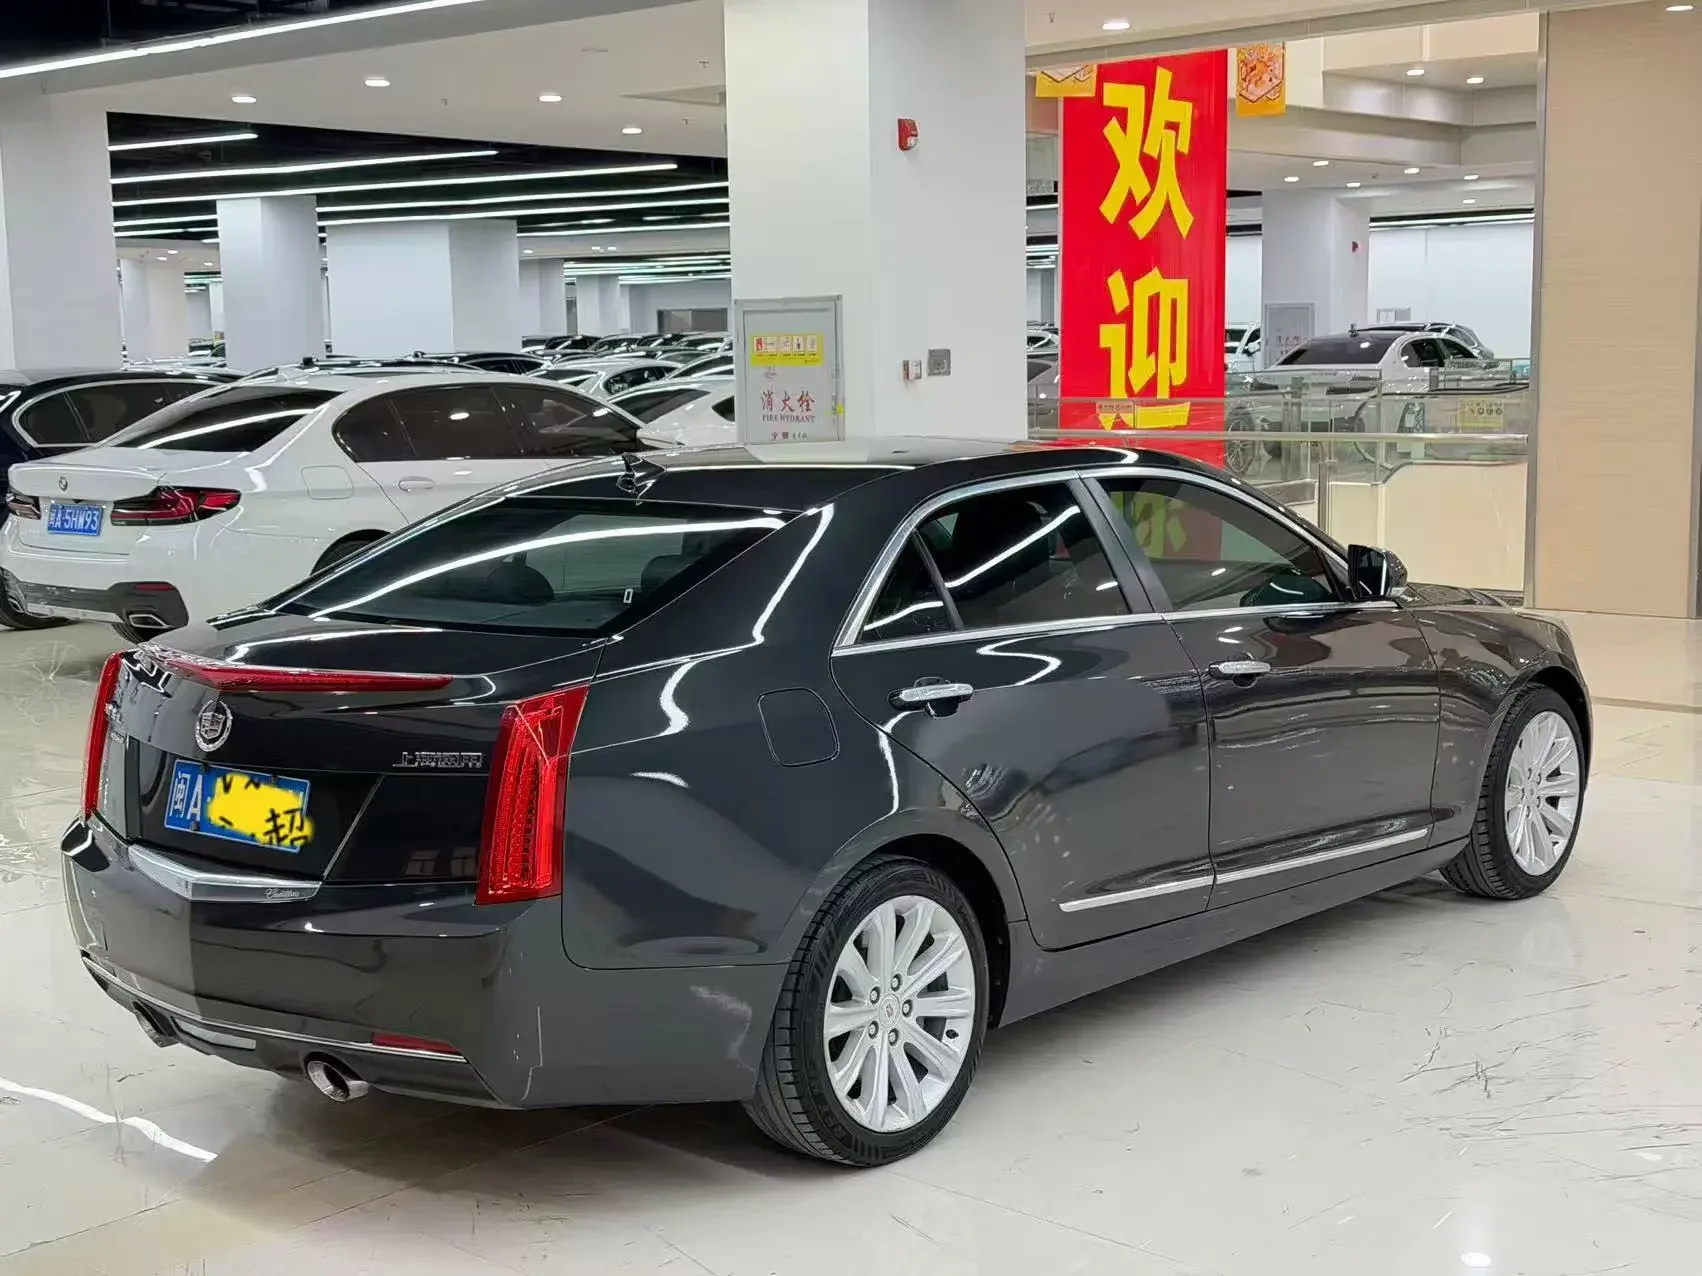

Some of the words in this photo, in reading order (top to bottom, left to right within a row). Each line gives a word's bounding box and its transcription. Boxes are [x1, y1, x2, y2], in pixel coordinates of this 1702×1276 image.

[1098, 65, 1195, 432] 欢迎
[761, 389, 815, 412] 消火栓
